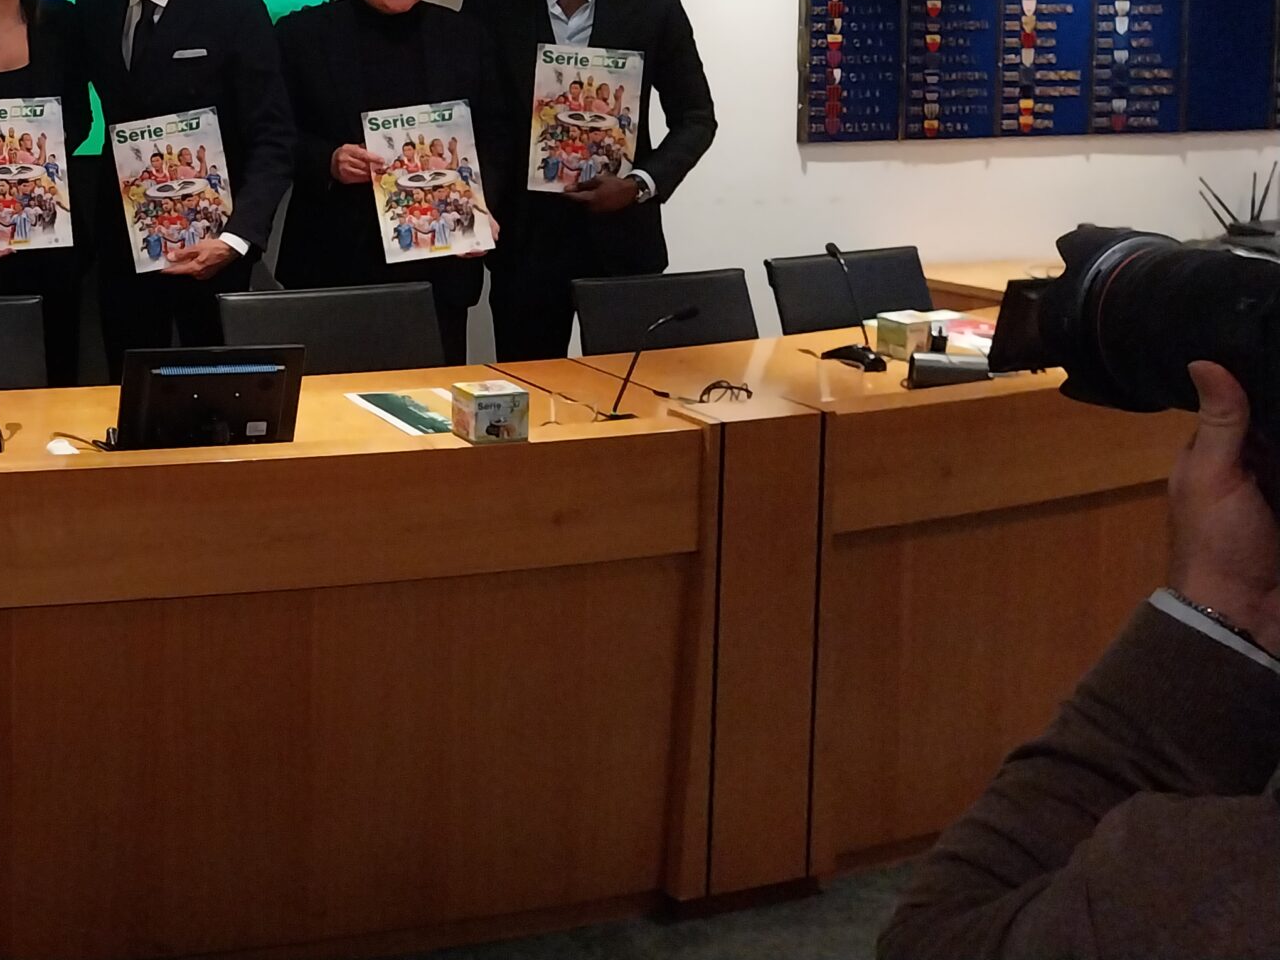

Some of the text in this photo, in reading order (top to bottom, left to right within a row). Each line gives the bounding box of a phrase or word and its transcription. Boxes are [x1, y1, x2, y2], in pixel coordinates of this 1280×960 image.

[542, 49, 628, 69] Serie KT
[367, 113, 416, 132] Serie
[115, 124, 164, 145] Serie
[477, 402, 502, 411] Serie
